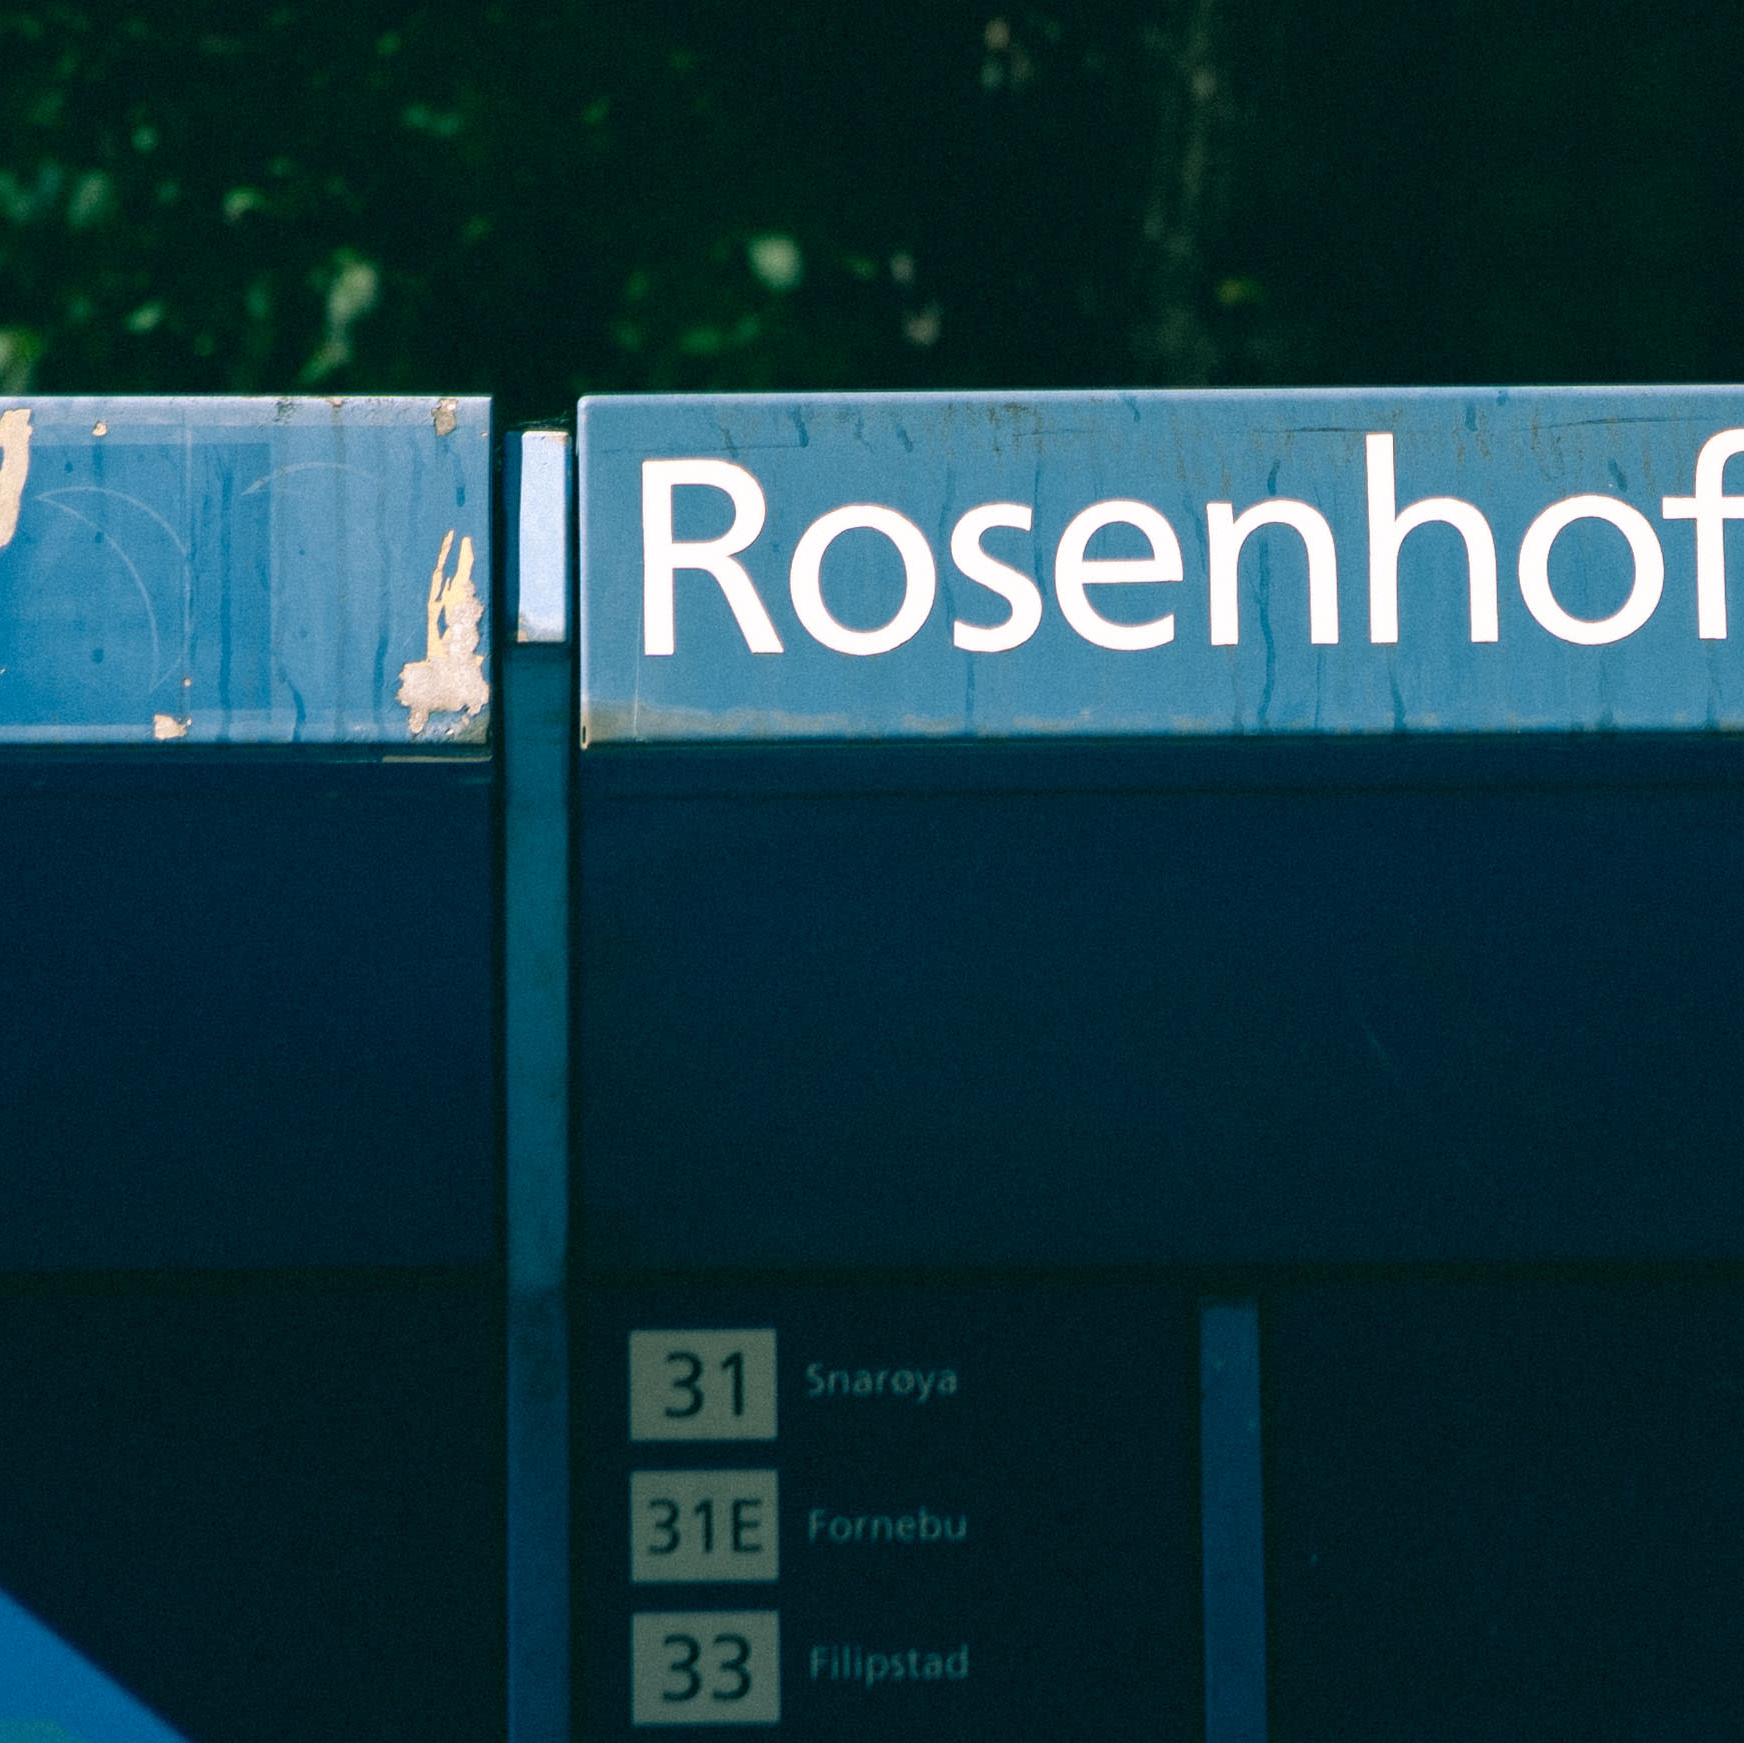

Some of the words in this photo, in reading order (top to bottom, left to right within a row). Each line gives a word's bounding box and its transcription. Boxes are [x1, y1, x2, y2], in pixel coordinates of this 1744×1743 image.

[662, 1350, 746, 1420] 31
[805, 1362, 959, 1403] Snarøya
[647, 1498, 763, 1556] 31E
[808, 1507, 969, 1544] Fornebu
[662, 1632, 753, 1704] 33
[809, 1643, 970, 1688] Filipstad
